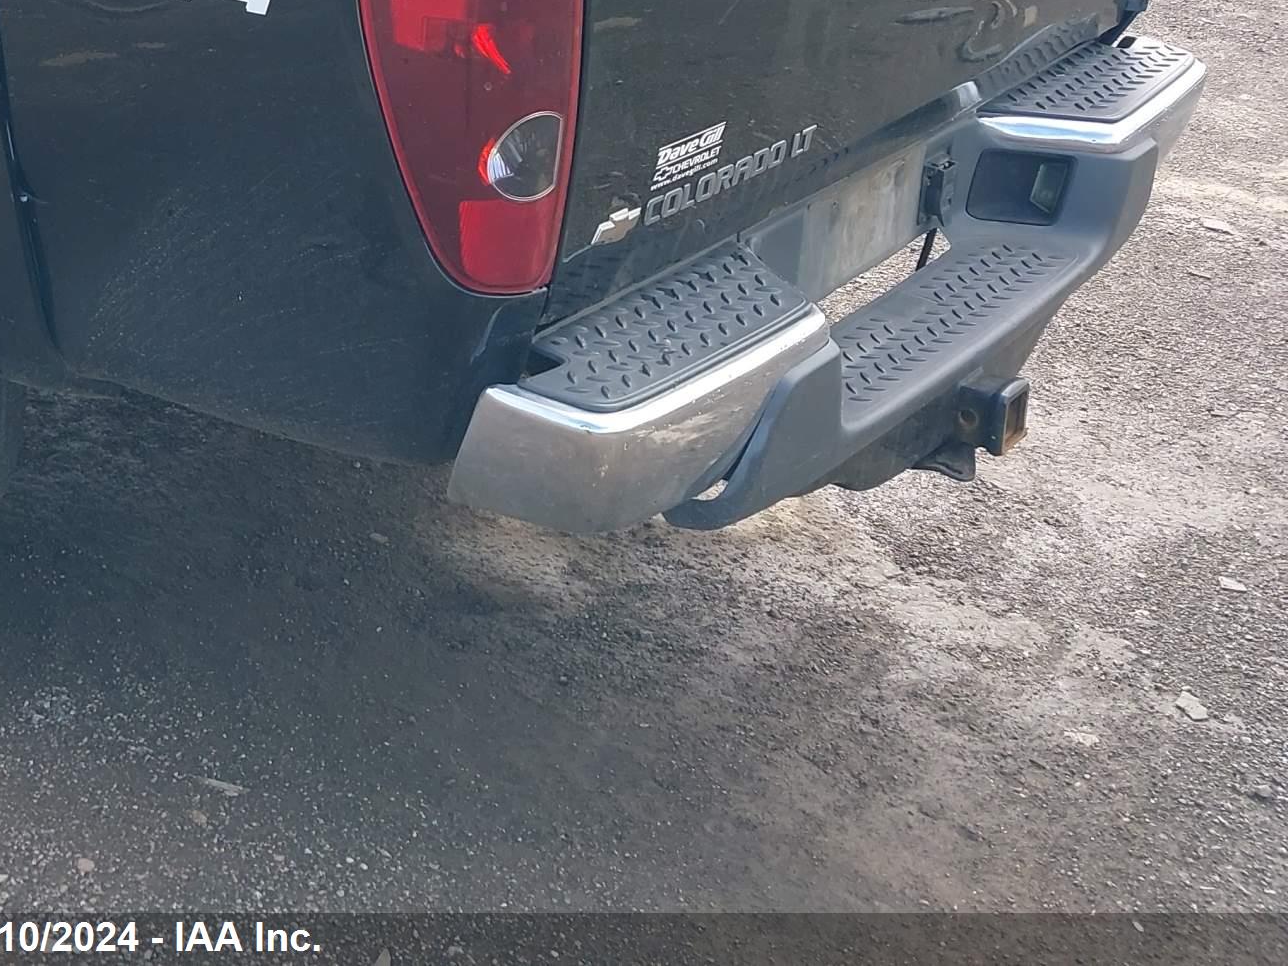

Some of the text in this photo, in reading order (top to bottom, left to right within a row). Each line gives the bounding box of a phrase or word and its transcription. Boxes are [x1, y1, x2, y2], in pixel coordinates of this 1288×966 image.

[657, 138, 700, 166] Dave
[672, 145, 722, 174] CHEVROLET
[643, 124, 818, 226] COLORADO LT
